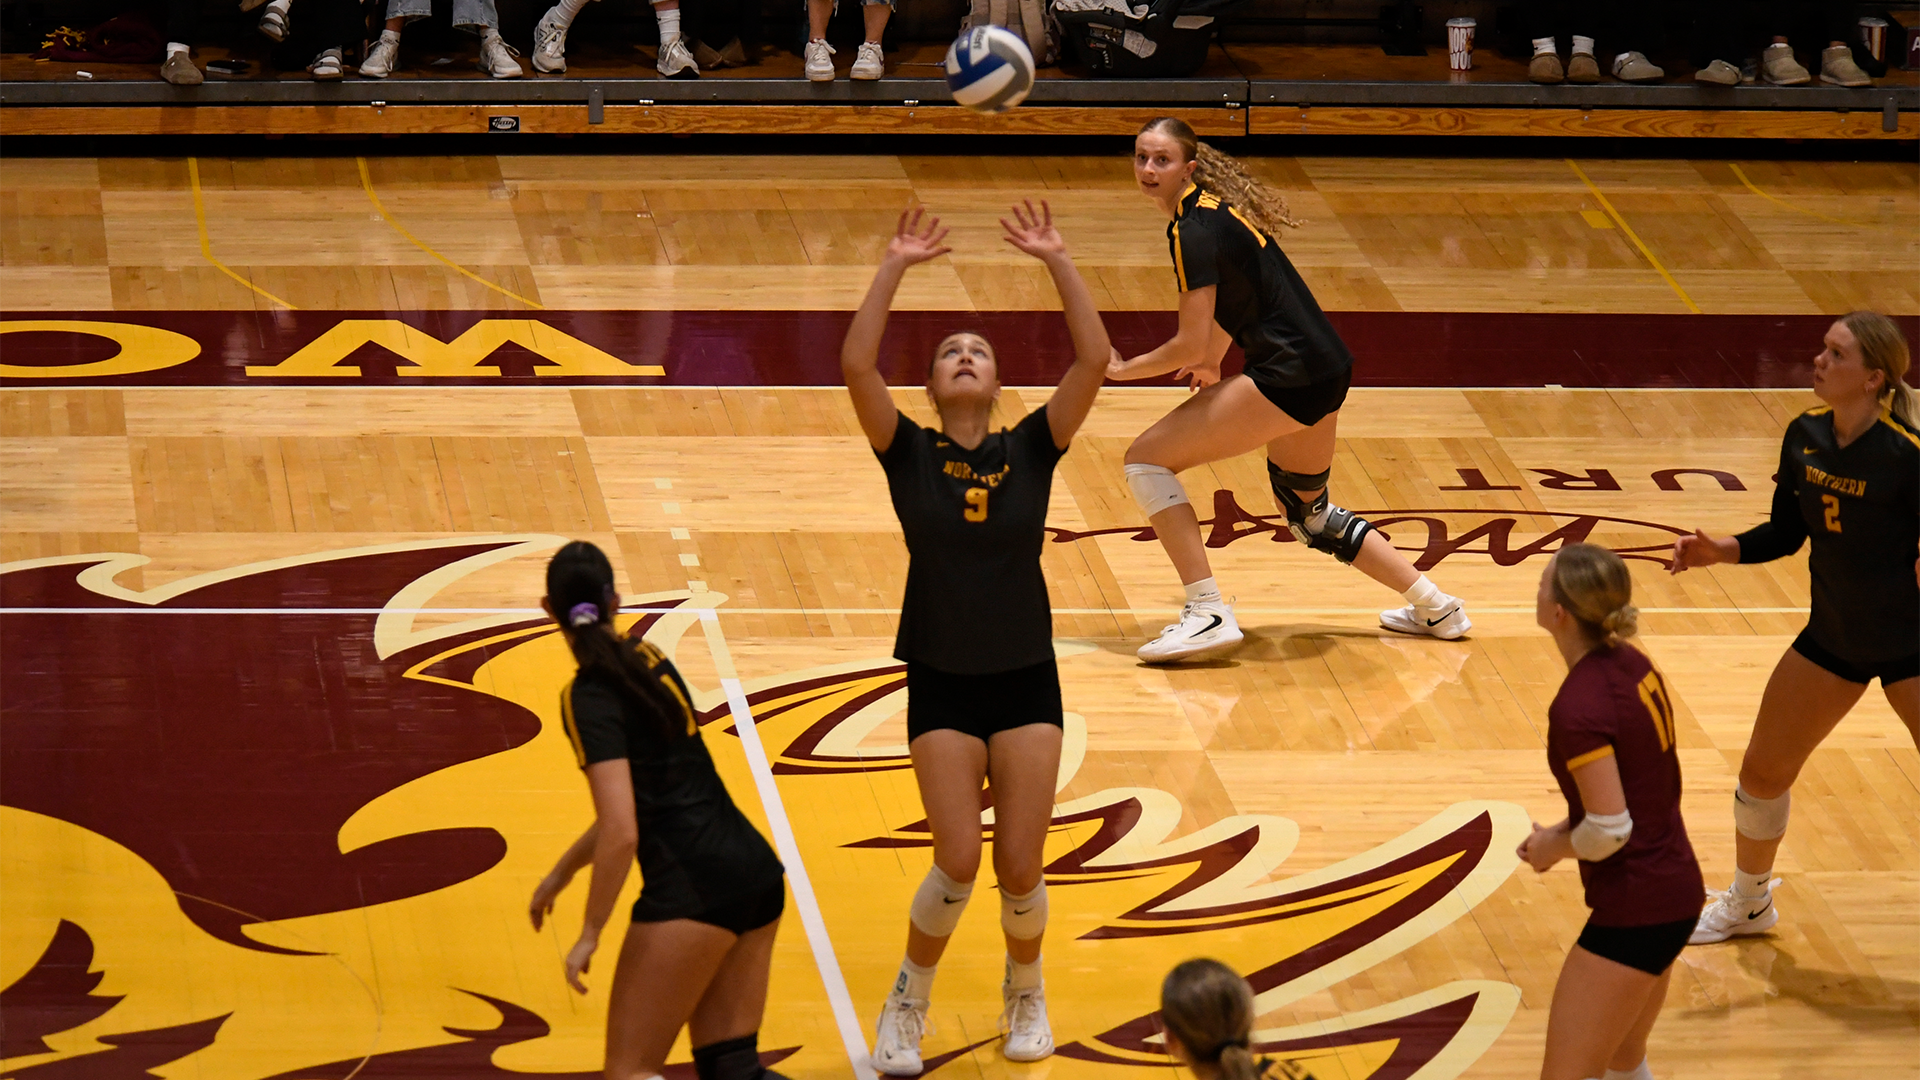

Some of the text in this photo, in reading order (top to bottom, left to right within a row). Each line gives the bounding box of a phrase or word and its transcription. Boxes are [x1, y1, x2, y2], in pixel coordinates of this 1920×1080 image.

[1438, 468, 1779, 491] URT
[1805, 465, 1867, 497] NORTHERN
[963, 487, 989, 522] 9
[1821, 494, 1843, 534] 2
[1637, 670, 1674, 753] 17
